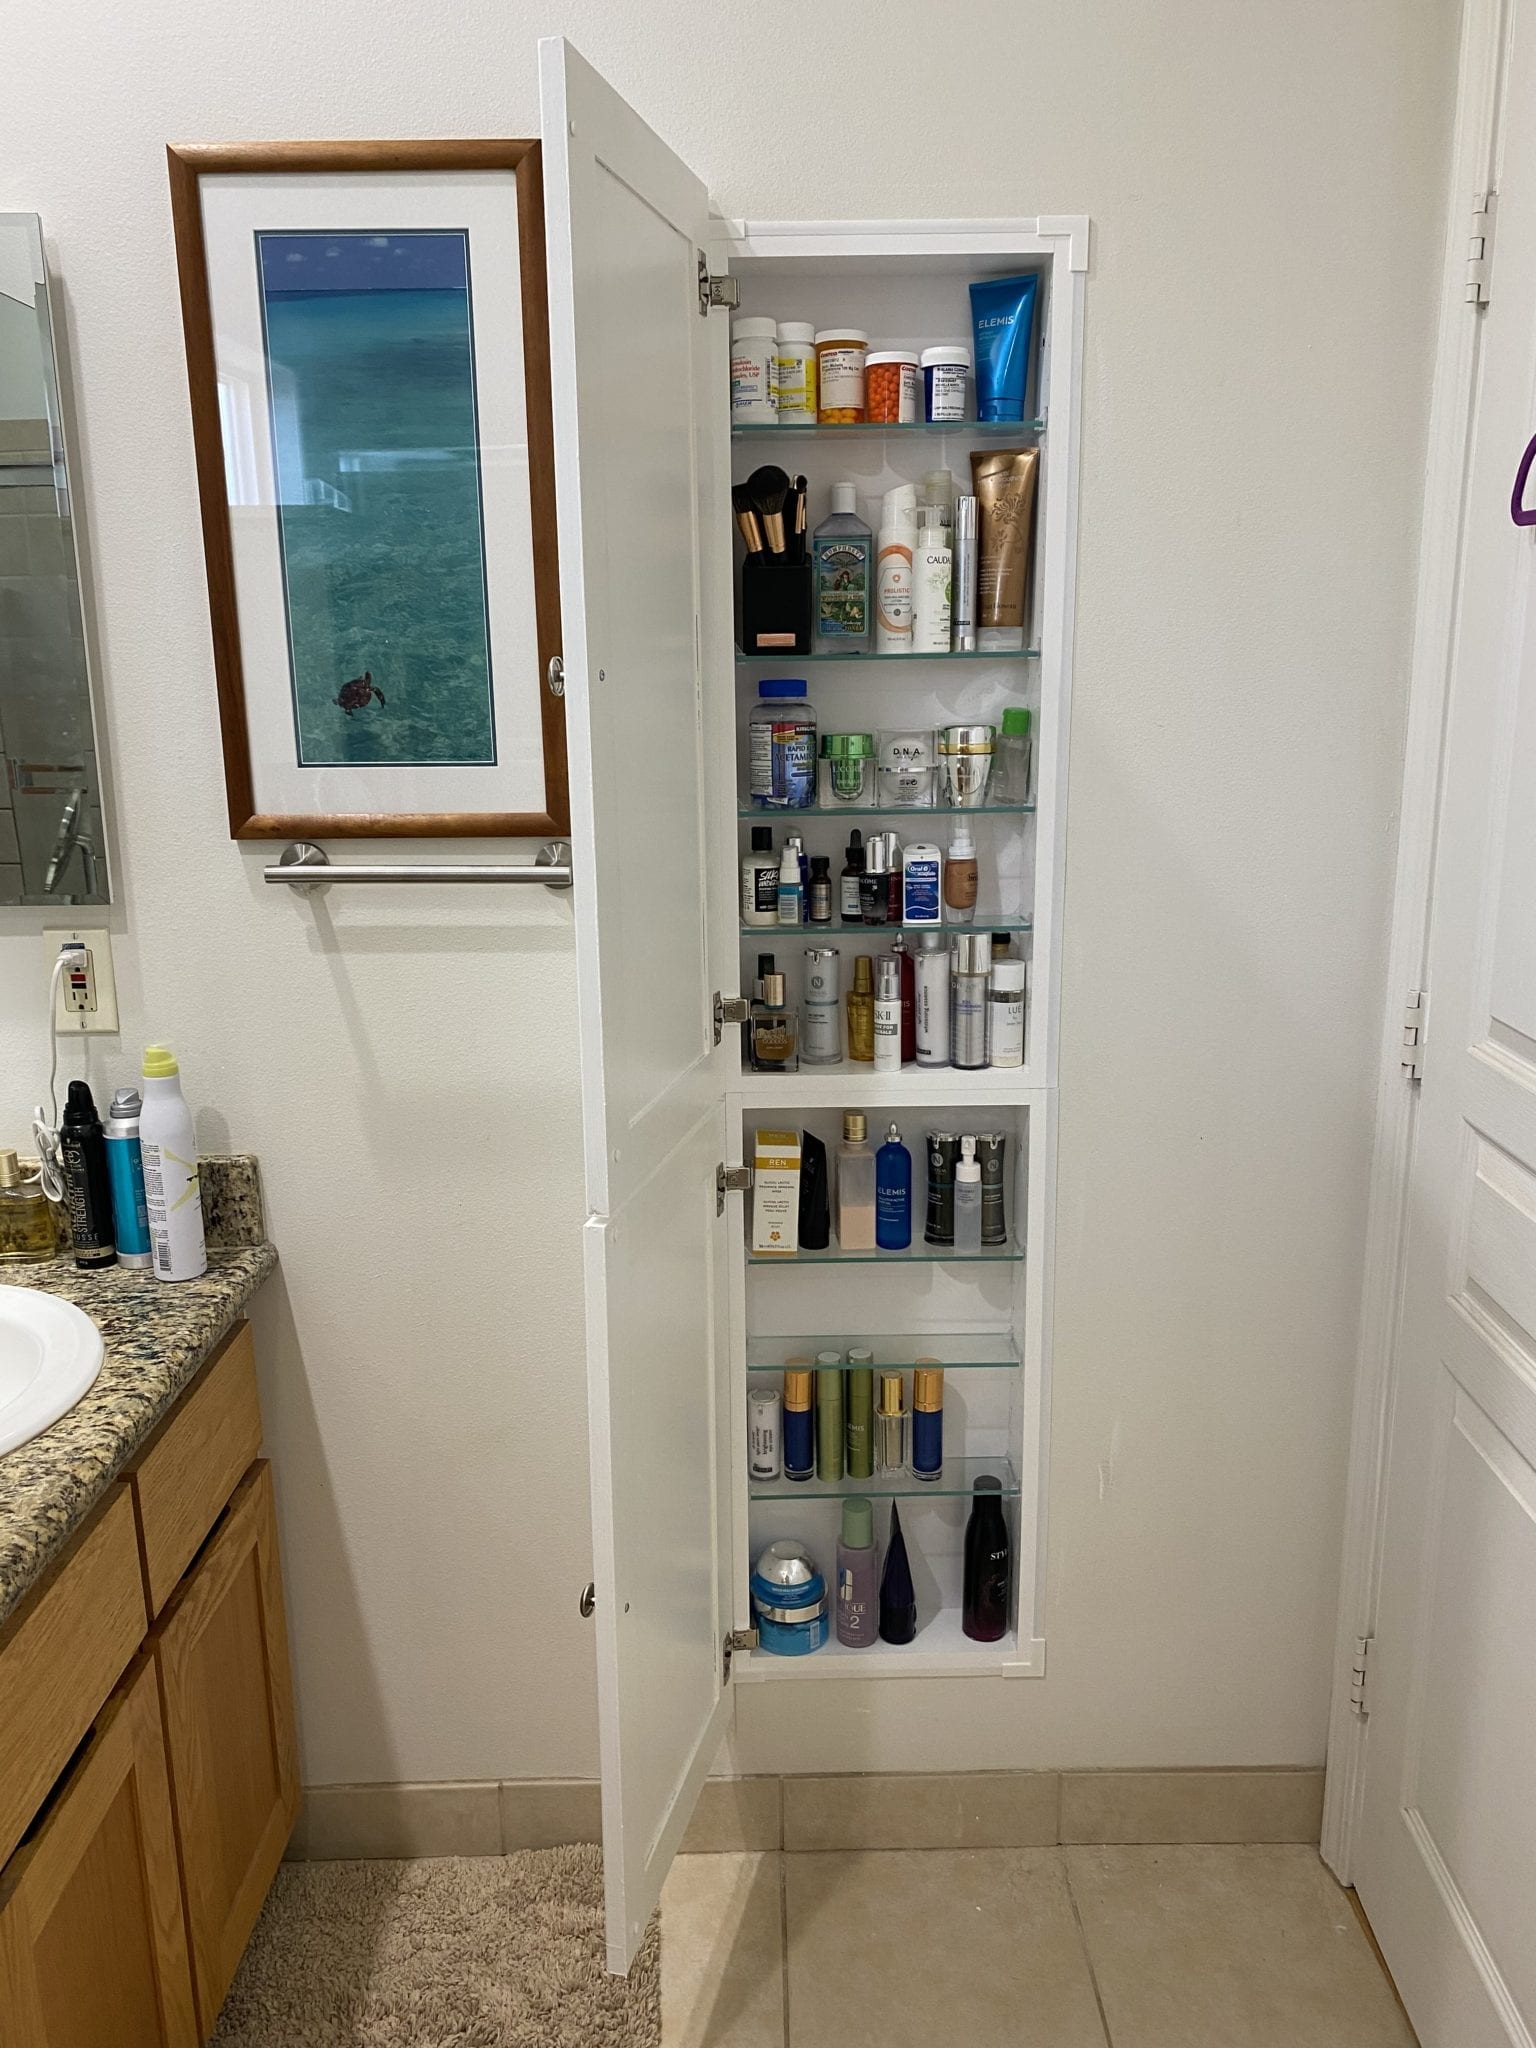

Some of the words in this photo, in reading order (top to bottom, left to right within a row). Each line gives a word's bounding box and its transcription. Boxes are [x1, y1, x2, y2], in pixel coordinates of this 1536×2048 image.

[978, 315, 1014, 329] ELEMIS
[878, 1186, 906, 1196] ELEMIS
[74, 1186, 88, 1233] STRENGTH
[850, 1615, 860, 1629] 2
